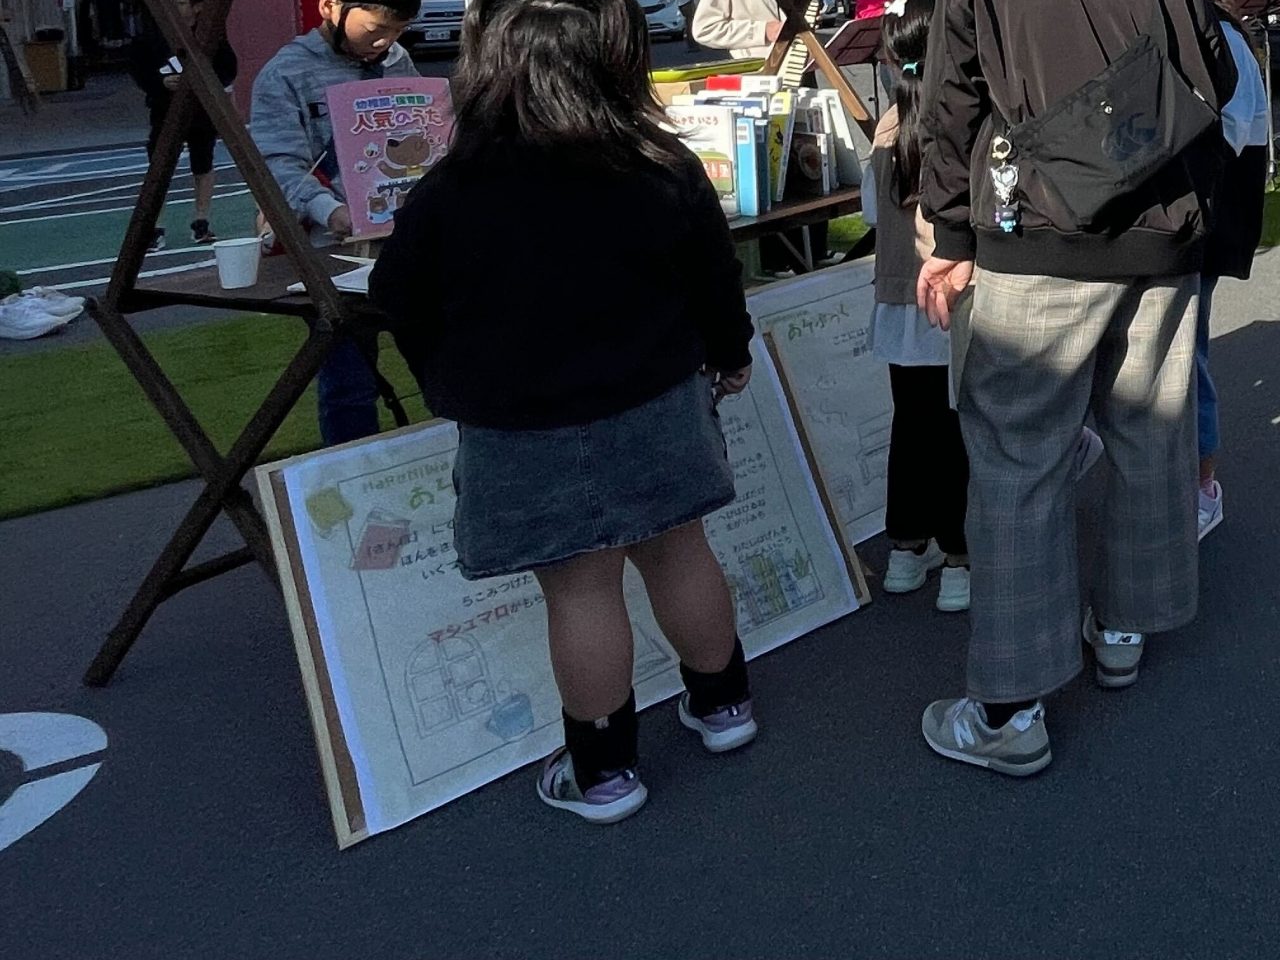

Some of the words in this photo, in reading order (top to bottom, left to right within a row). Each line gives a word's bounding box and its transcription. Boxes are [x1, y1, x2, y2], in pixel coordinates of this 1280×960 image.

[351, 107, 445, 134] 人気のうた
